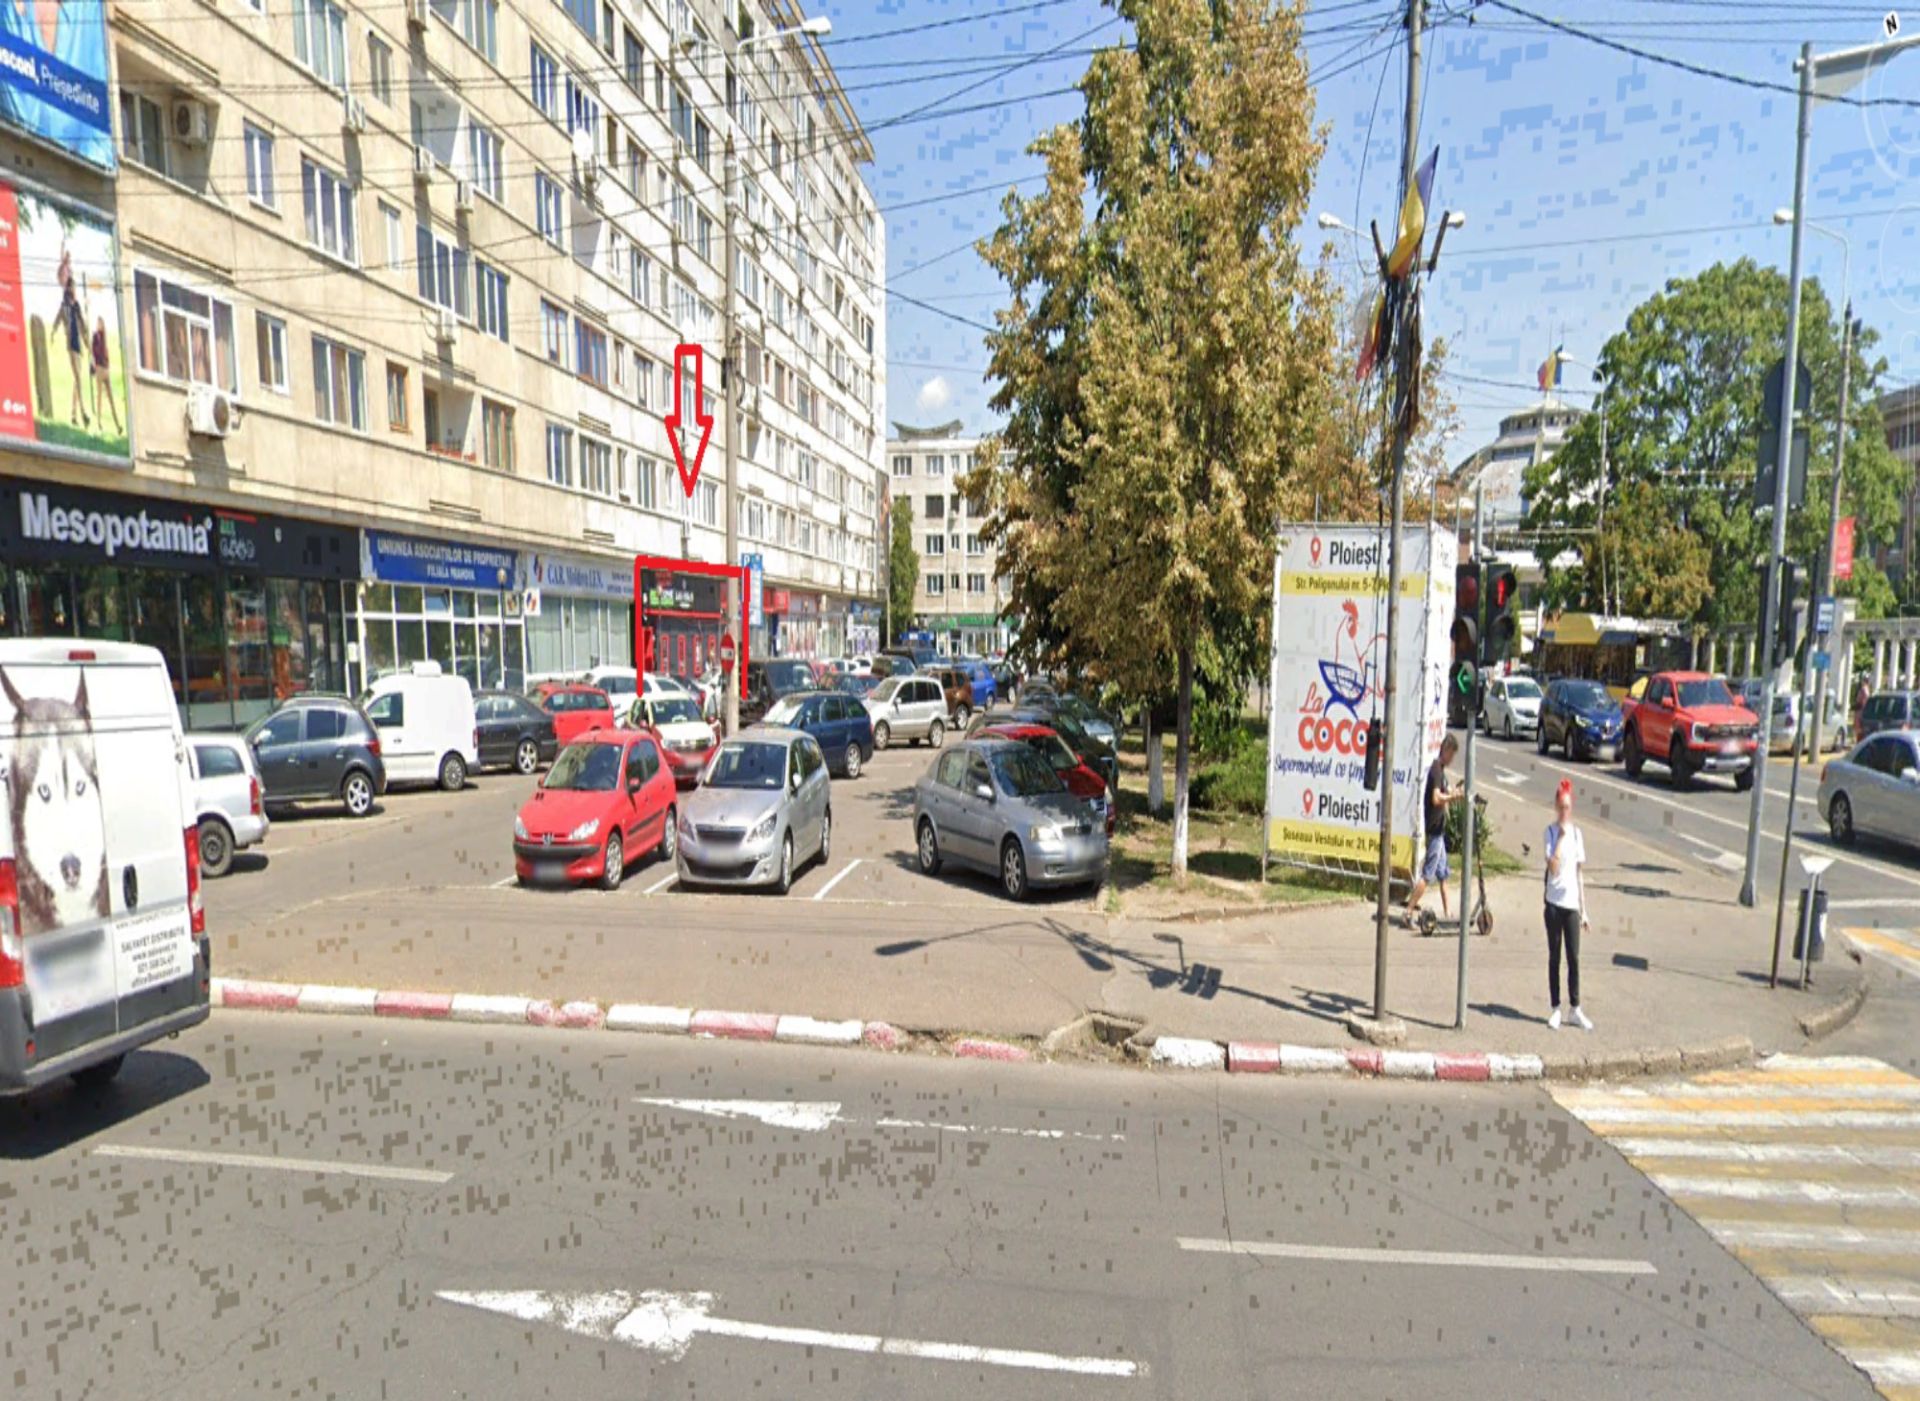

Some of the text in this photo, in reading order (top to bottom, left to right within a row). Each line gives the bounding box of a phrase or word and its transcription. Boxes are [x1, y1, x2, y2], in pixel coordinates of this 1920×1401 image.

[19, 492, 209, 556] Mesopotamia
[1299, 681, 1324, 713] La
[1319, 794, 1370, 827] Ploiești
